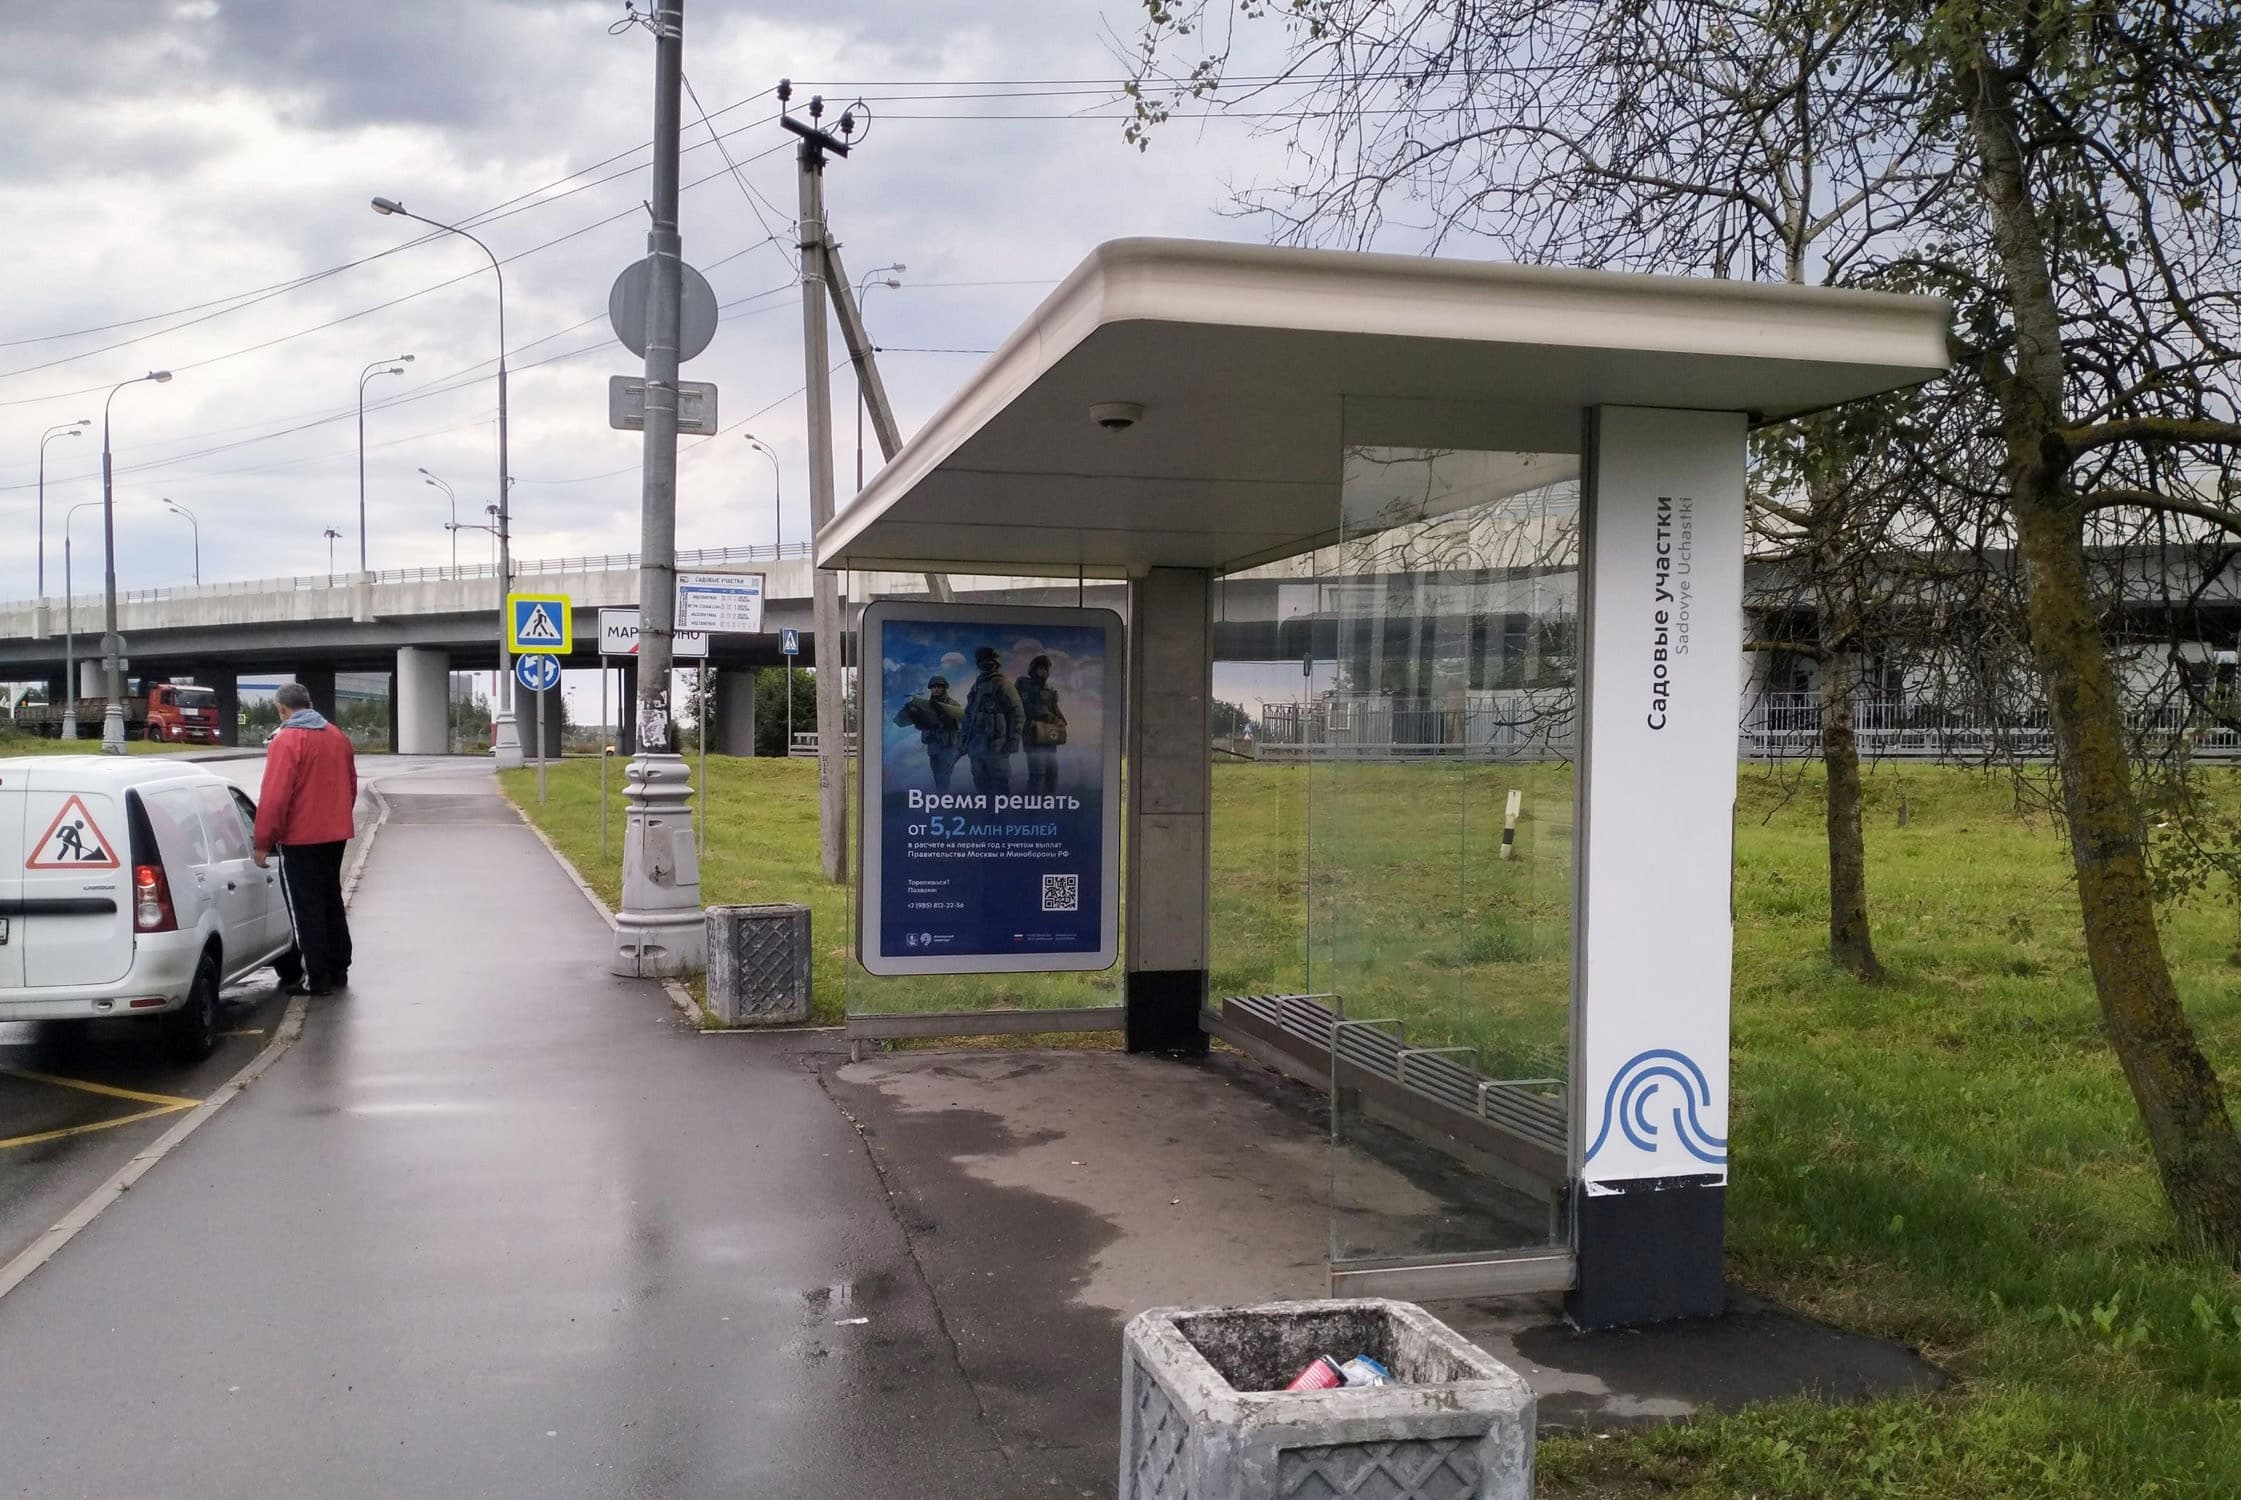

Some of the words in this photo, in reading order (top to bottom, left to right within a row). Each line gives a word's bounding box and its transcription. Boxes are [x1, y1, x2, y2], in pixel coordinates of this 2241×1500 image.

[1655, 496, 1674, 603] участки
[1677, 496, 1694, 575] Uchastki
[1675, 580, 1694, 656] Sadovye
[1647, 609, 1671, 731] Садовые
[908, 789, 987, 813] Время
[994, 794, 1080, 813] решать
[930, 816, 966, 839] 5,2
[1006, 822, 1057, 836] РУБЛЕЙ
[957, 841, 986, 849] первый
[907, 850, 966, 858] Правительства
[967, 850, 999, 858] Москвы
[1006, 850, 1056, 858] Минобороны
[1057, 850, 1070, 858] РФ
